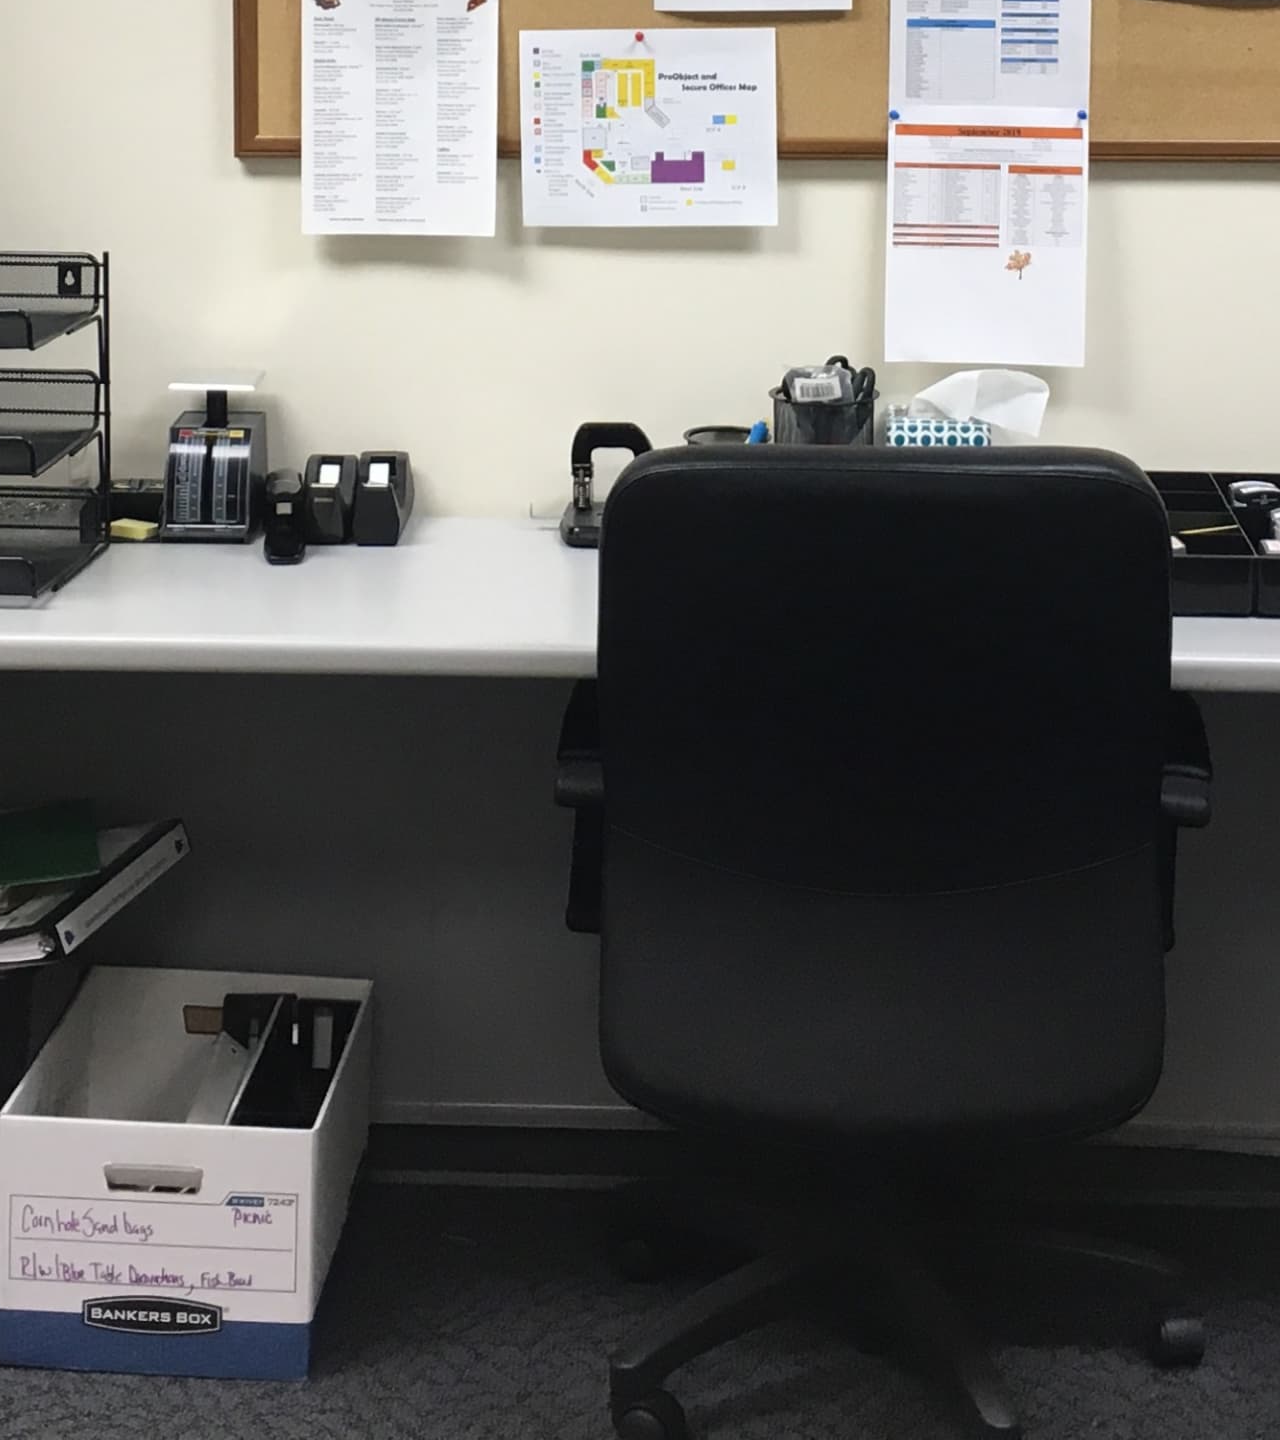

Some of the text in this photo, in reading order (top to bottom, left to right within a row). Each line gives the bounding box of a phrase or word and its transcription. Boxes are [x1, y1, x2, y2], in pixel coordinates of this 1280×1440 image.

[701, 72, 718, 80] and
[682, 83, 707, 91] Secure
[738, 83, 758, 92] Map
[122, 1211, 154, 1242] bags
[90, 1307, 213, 1326] BANKERS BOX
